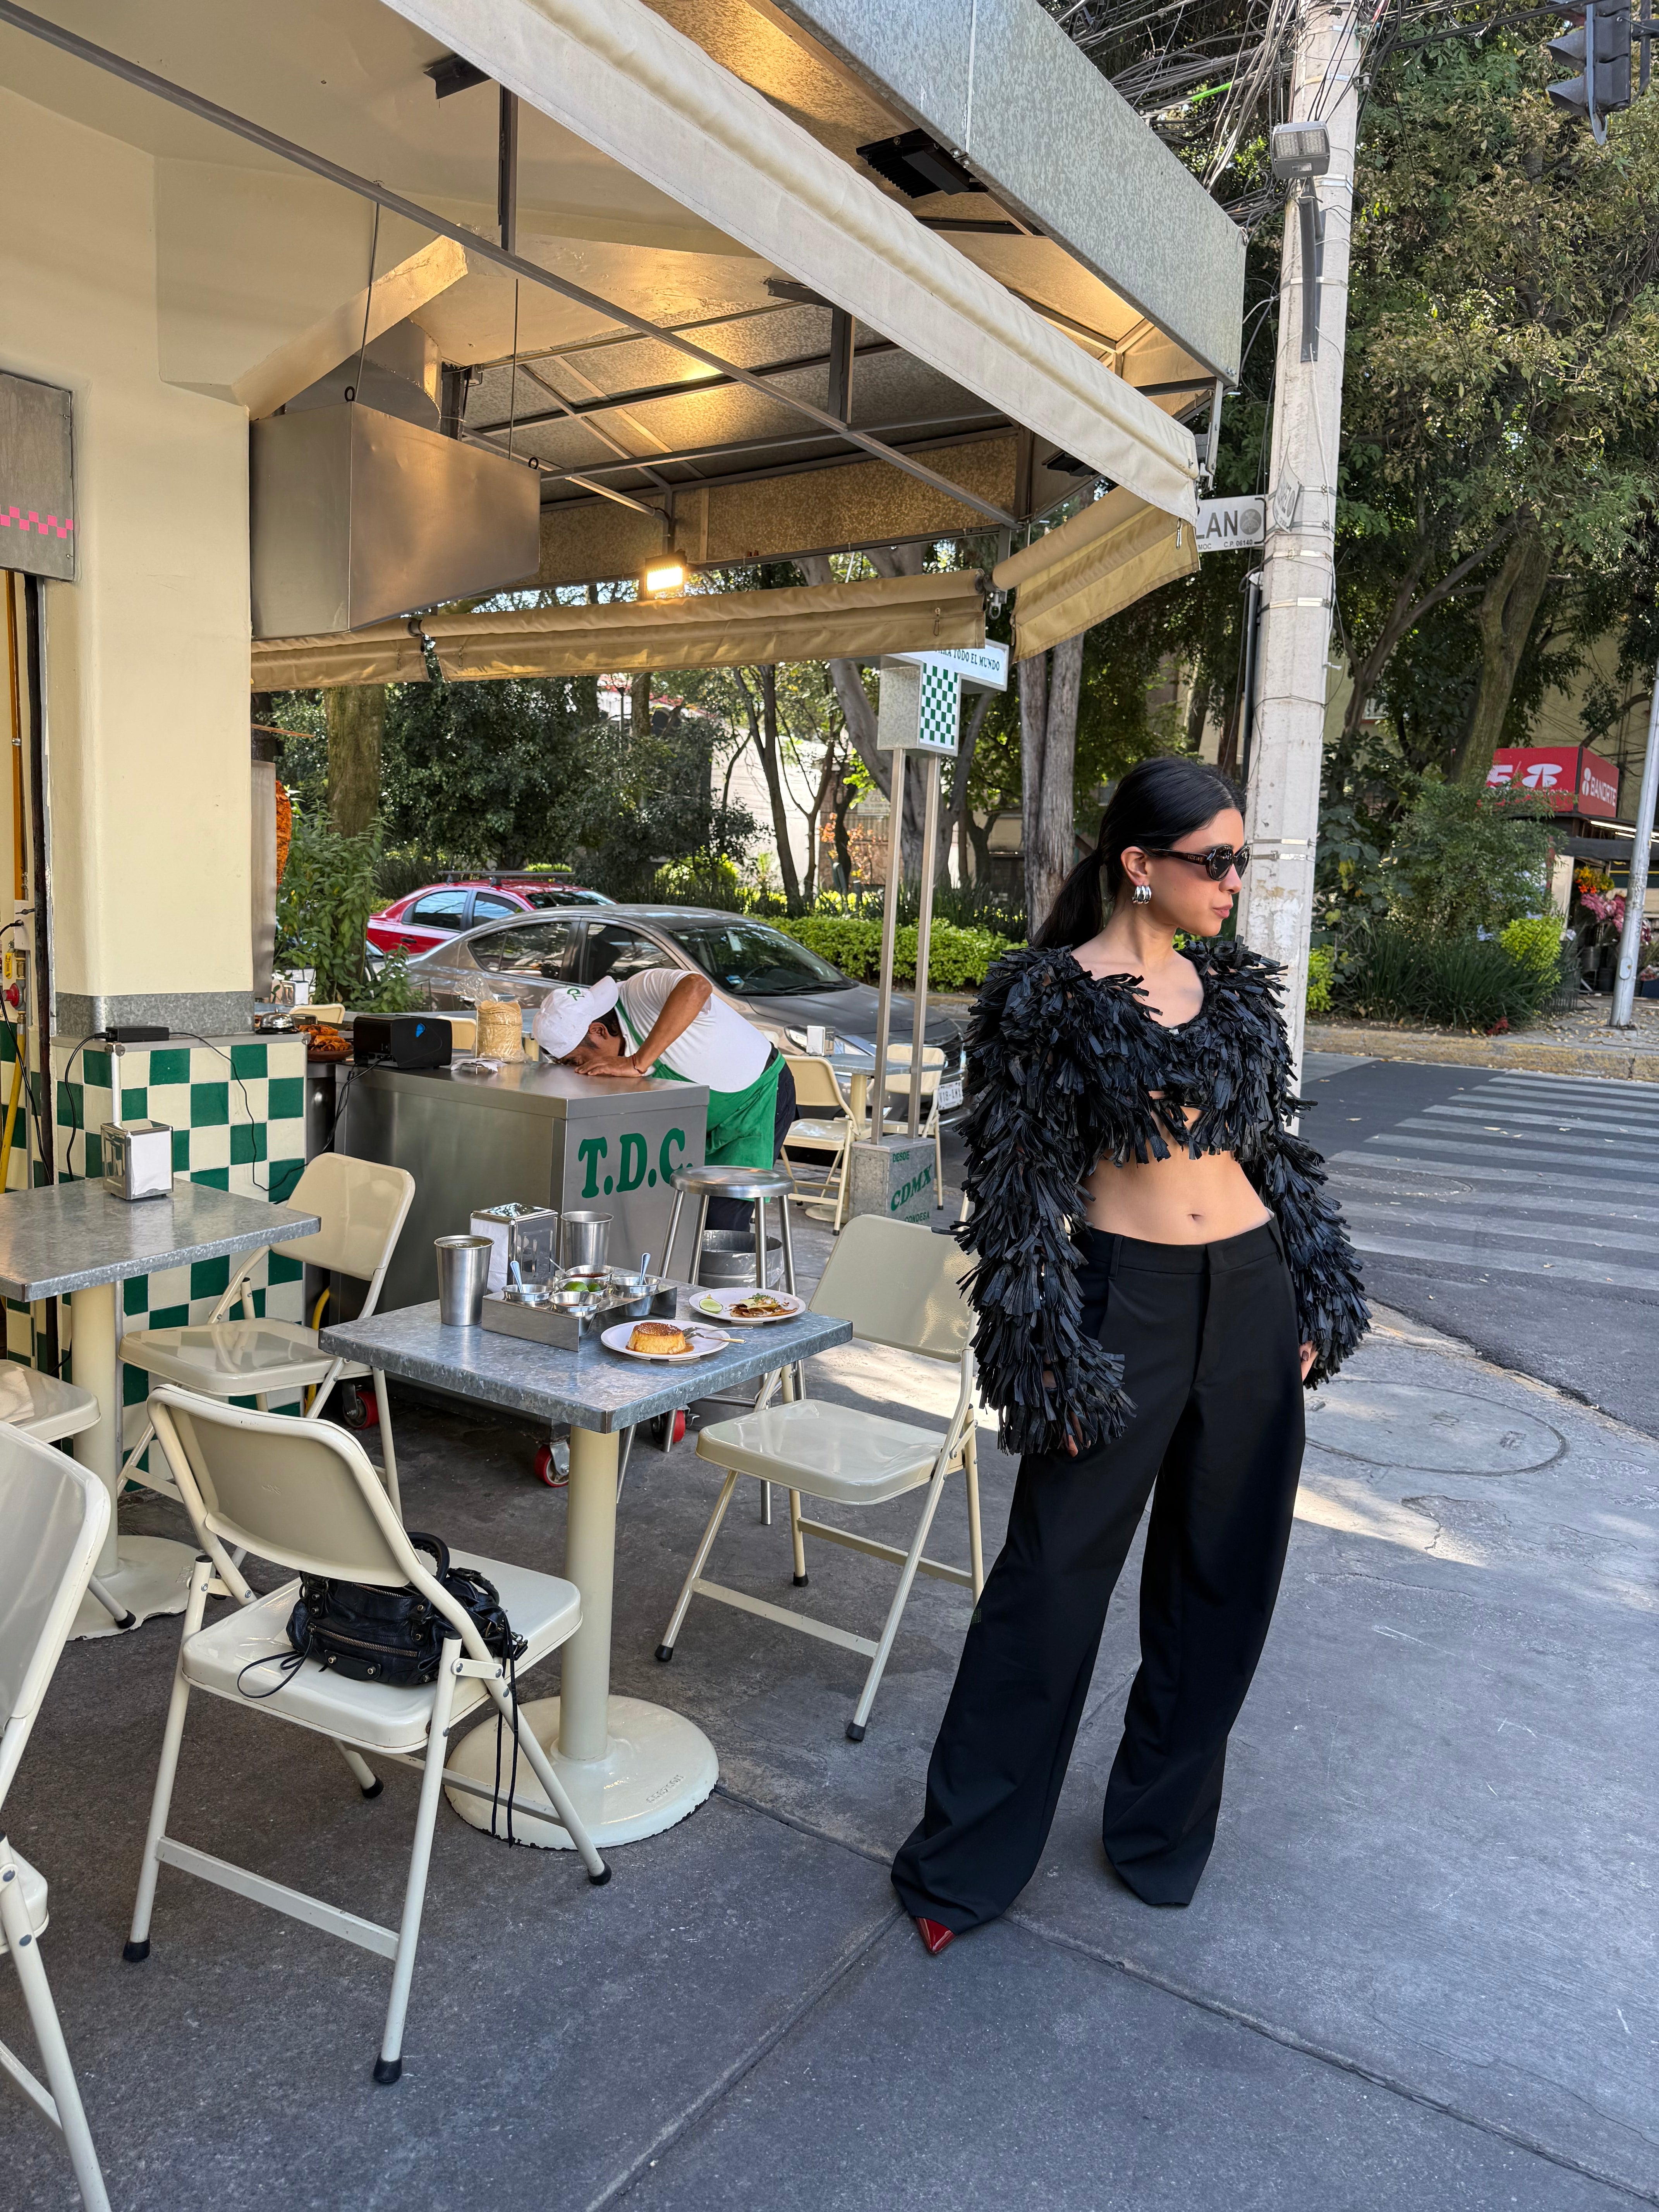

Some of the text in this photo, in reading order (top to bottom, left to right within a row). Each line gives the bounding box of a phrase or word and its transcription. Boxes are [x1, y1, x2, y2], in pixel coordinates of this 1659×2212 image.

[1196, 510, 1238, 539] AN
[971, 653, 977, 665] EL
[979, 656, 1000, 671] MUNDO
[893, 1151, 910, 1163] DESDE
[891, 1164, 932, 1211] CDMX
